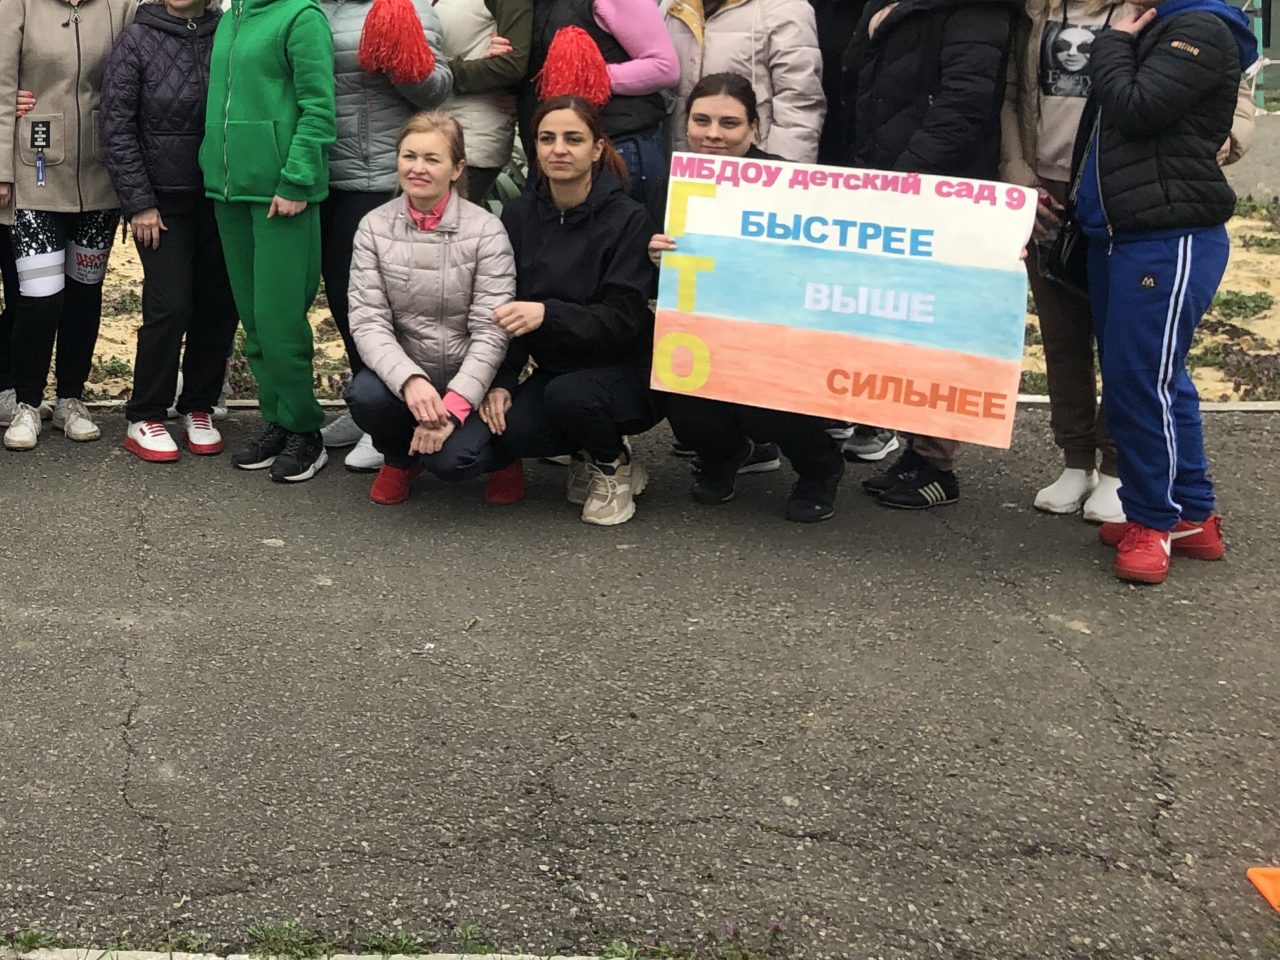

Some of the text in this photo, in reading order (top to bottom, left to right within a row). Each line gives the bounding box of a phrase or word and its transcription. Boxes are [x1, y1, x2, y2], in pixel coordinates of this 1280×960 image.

[671, 155, 1027, 211] МБДОУ детский сад 9
[740, 210, 935, 257] БЫСТРЕЕ
[803, 281, 936, 323] ВЫШЕ
[825, 368, 1008, 421] СИЛЬНЕЕ
